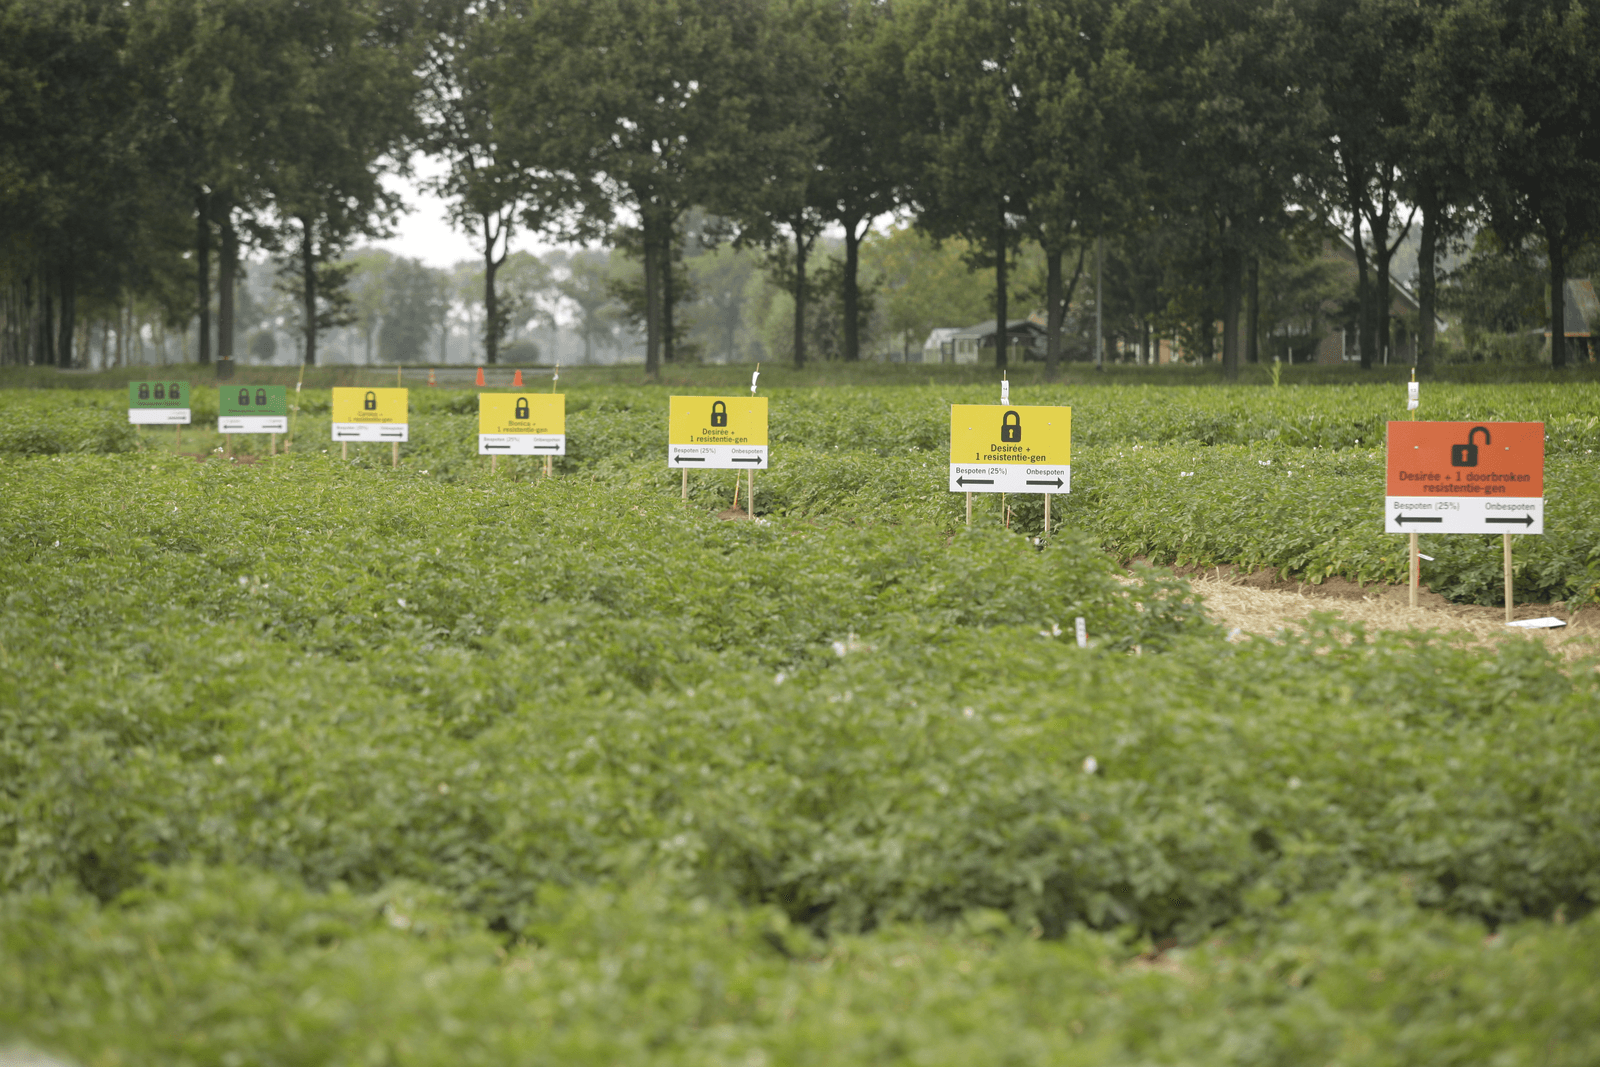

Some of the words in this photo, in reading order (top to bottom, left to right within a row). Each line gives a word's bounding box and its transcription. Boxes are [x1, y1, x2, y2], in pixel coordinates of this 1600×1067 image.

[696, 436, 748, 444] resistentie-gen
[990, 443, 1023, 452] Desirée
[976, 452, 980, 460] 1
[983, 453, 1046, 463] resistentie-gen
[955, 467, 986, 475] Bespoten
[988, 467, 1007, 475] (25%)
[1026, 468, 1064, 476] Onbespoten
[1399, 471, 1441, 481] Desirée
[1456, 471, 1461, 481] 1
[1466, 471, 1530, 482] doorbroken
[1423, 483, 1506, 495] resistentie-gen
[1394, 502, 1432, 511] Bespoten
[1435, 502, 1460, 511] (25%)
[1485, 502, 1535, 512] Onbespoten
